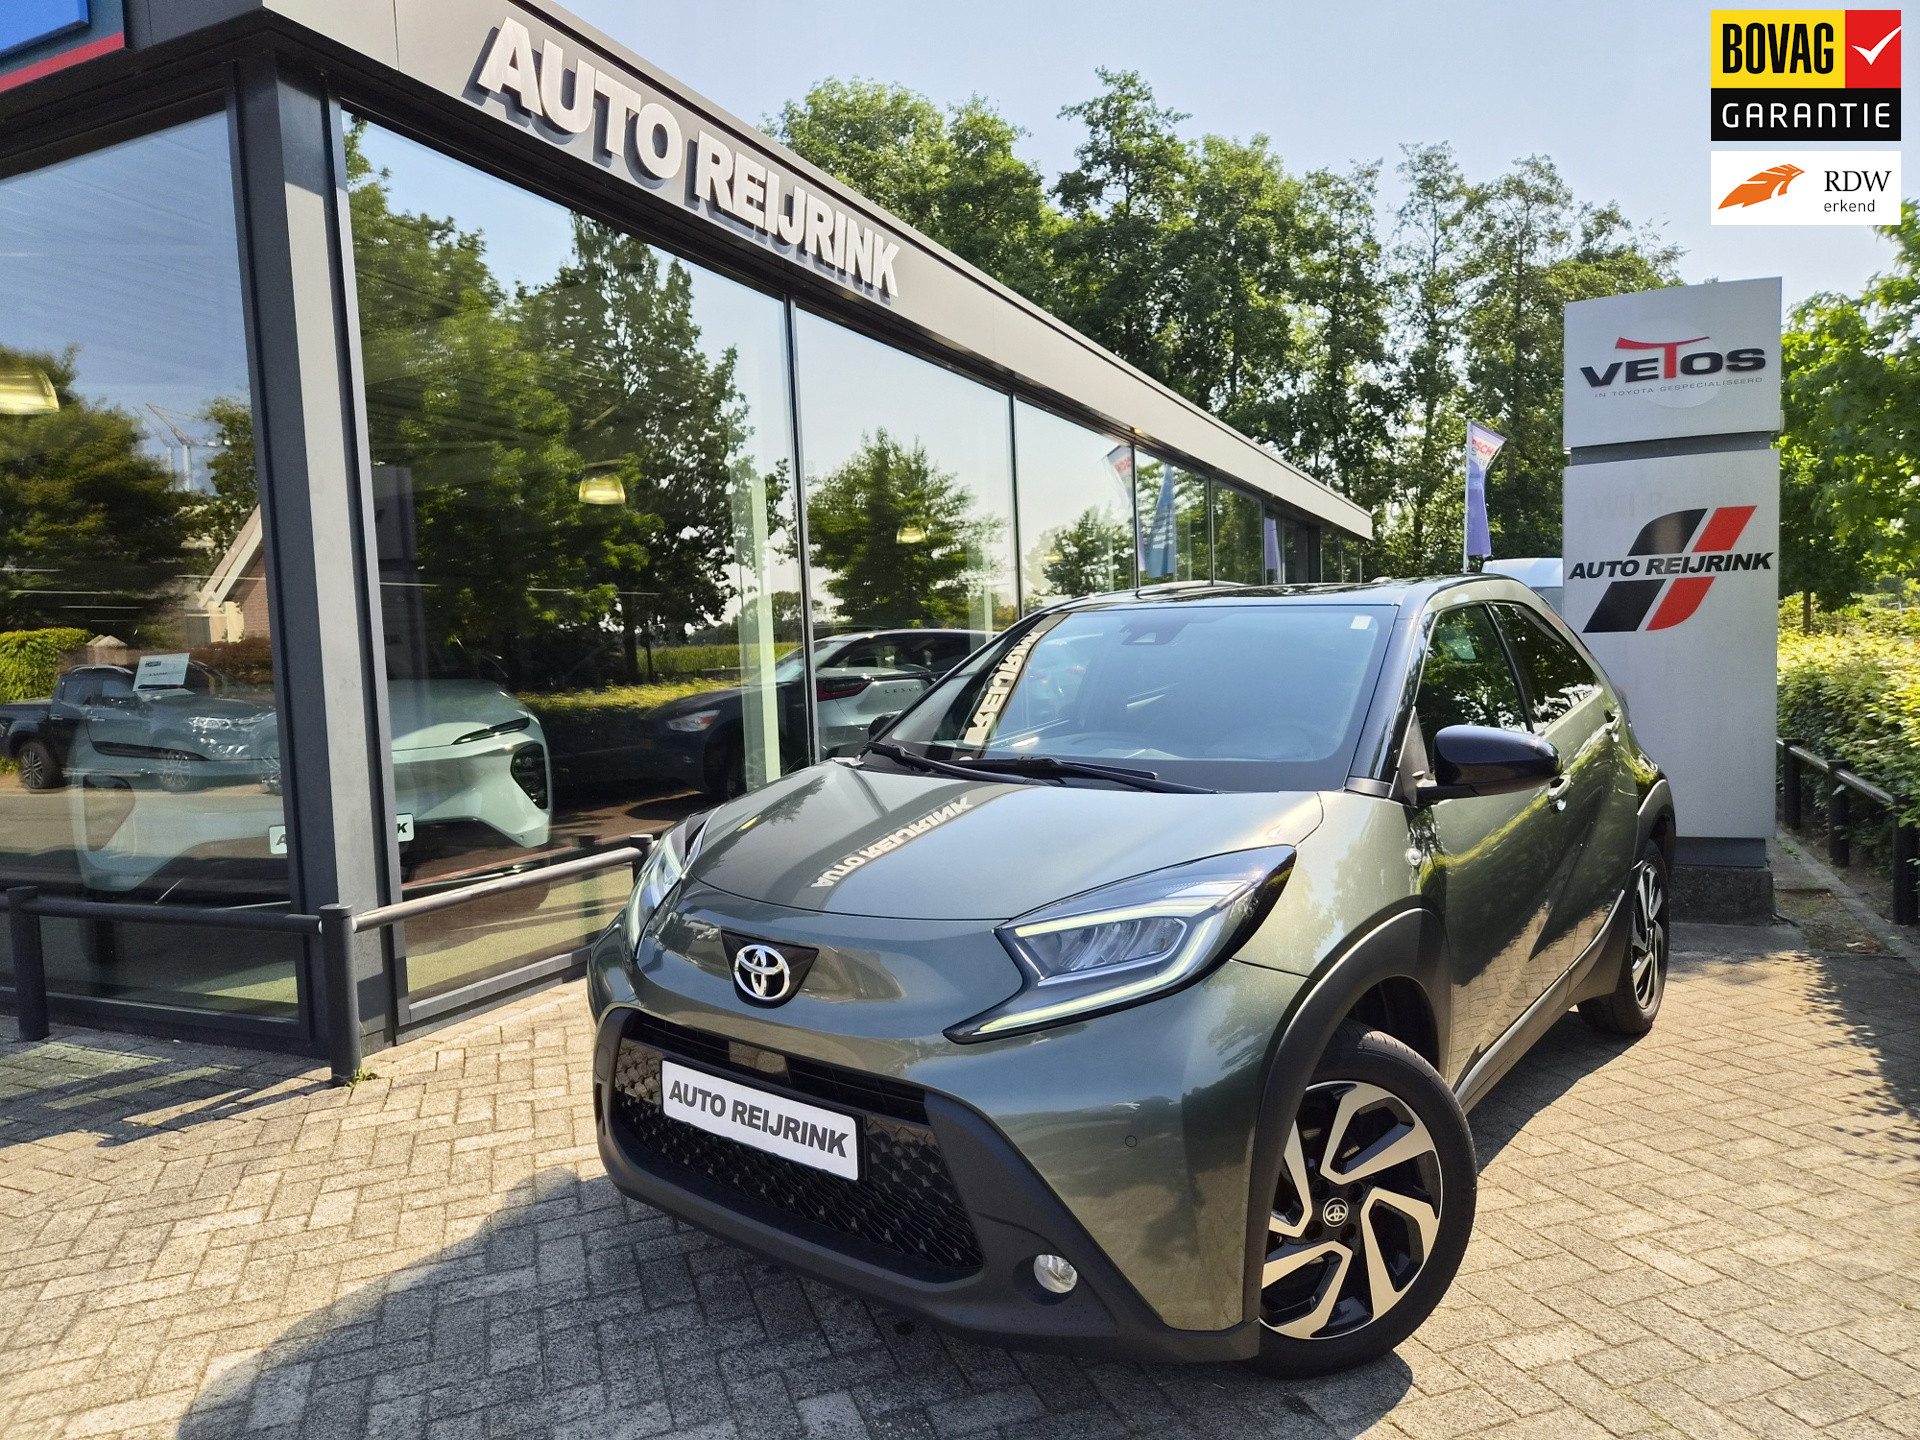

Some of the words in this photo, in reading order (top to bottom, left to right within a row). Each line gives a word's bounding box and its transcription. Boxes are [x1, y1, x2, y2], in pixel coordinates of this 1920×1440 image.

[477, 16, 683, 180] AUTO
[694, 130, 901, 297] REIJRINK
[1580, 336, 1767, 388] VETOS
[1612, 388, 1654, 397] TOYOTA
[1660, 377, 1763, 392] GESPECIALISEERD
[1568, 559, 1640, 580] AUTO
[1645, 552, 1775, 576] REIJRINK
[668, 1080, 727, 1117] AUTO
[731, 1100, 849, 1158] REIJRINK
